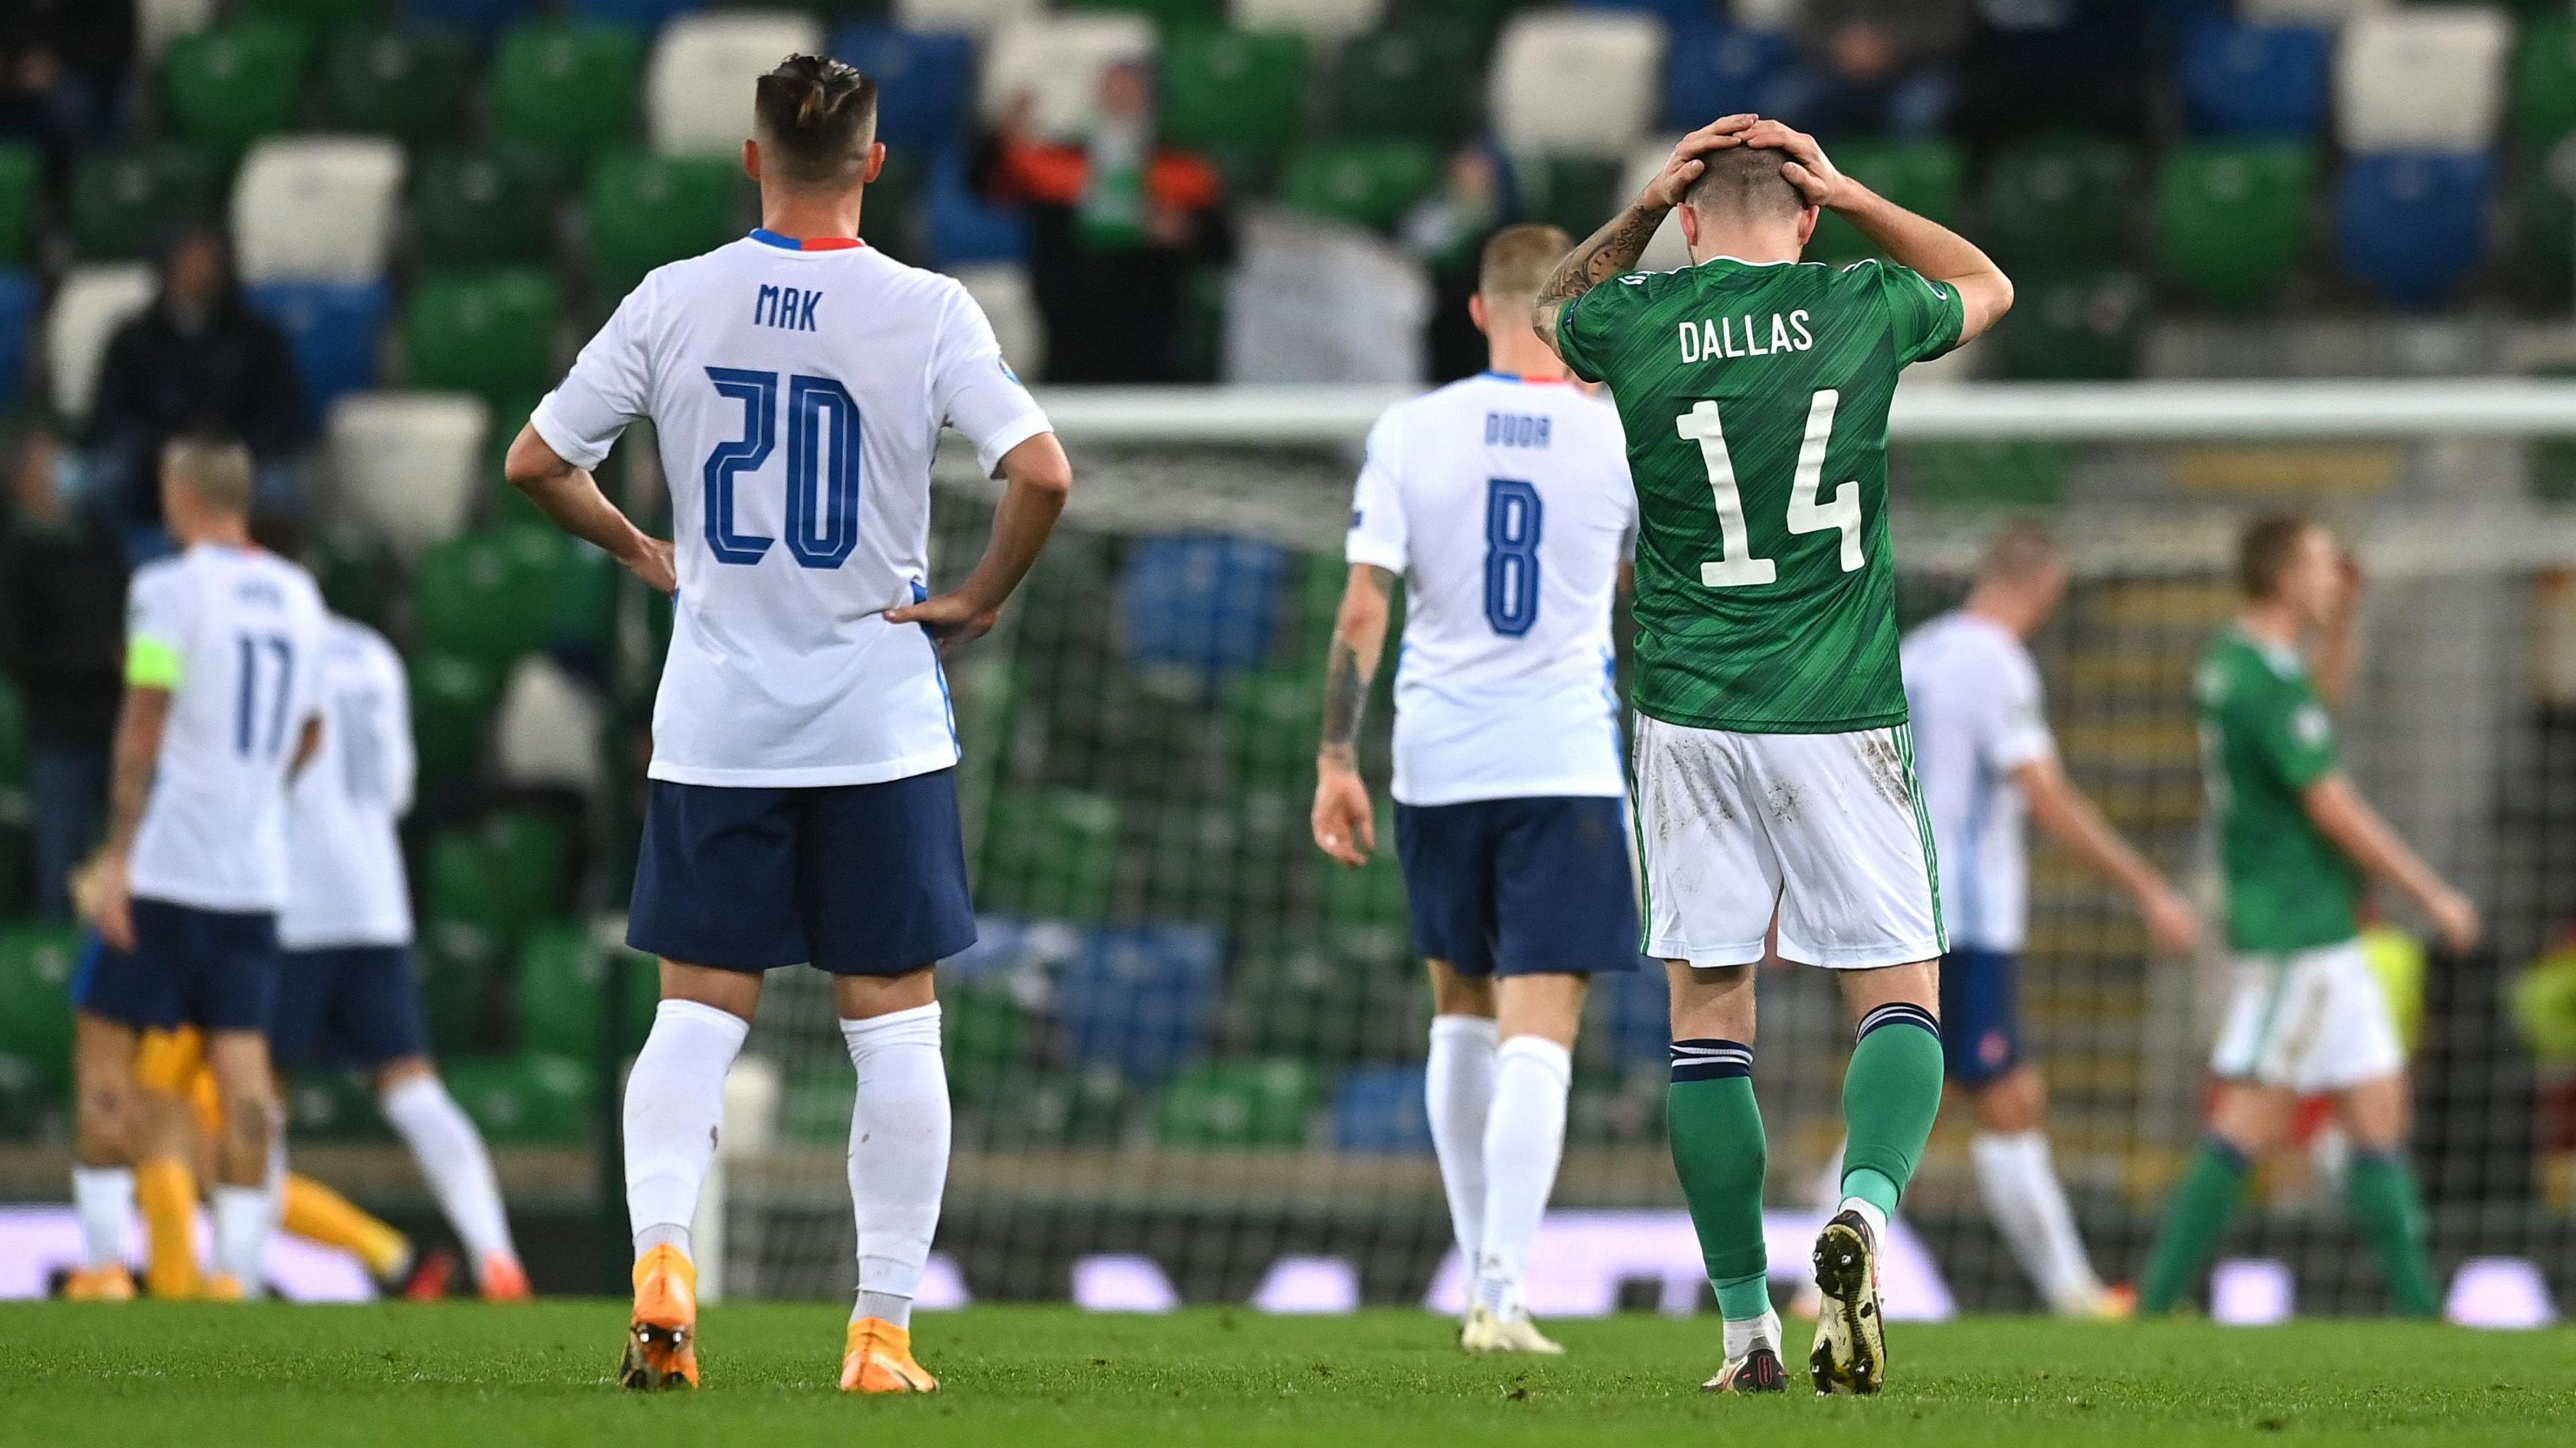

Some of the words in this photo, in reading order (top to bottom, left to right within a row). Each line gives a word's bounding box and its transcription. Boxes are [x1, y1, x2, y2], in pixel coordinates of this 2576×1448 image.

[754, 284, 823, 332] MAK
[1678, 309, 1813, 364] DALLAS
[704, 366, 860, 569] 20
[1676, 388, 1865, 587] 14
[1485, 478, 1544, 638] 8
[237, 634, 294, 761] 17
